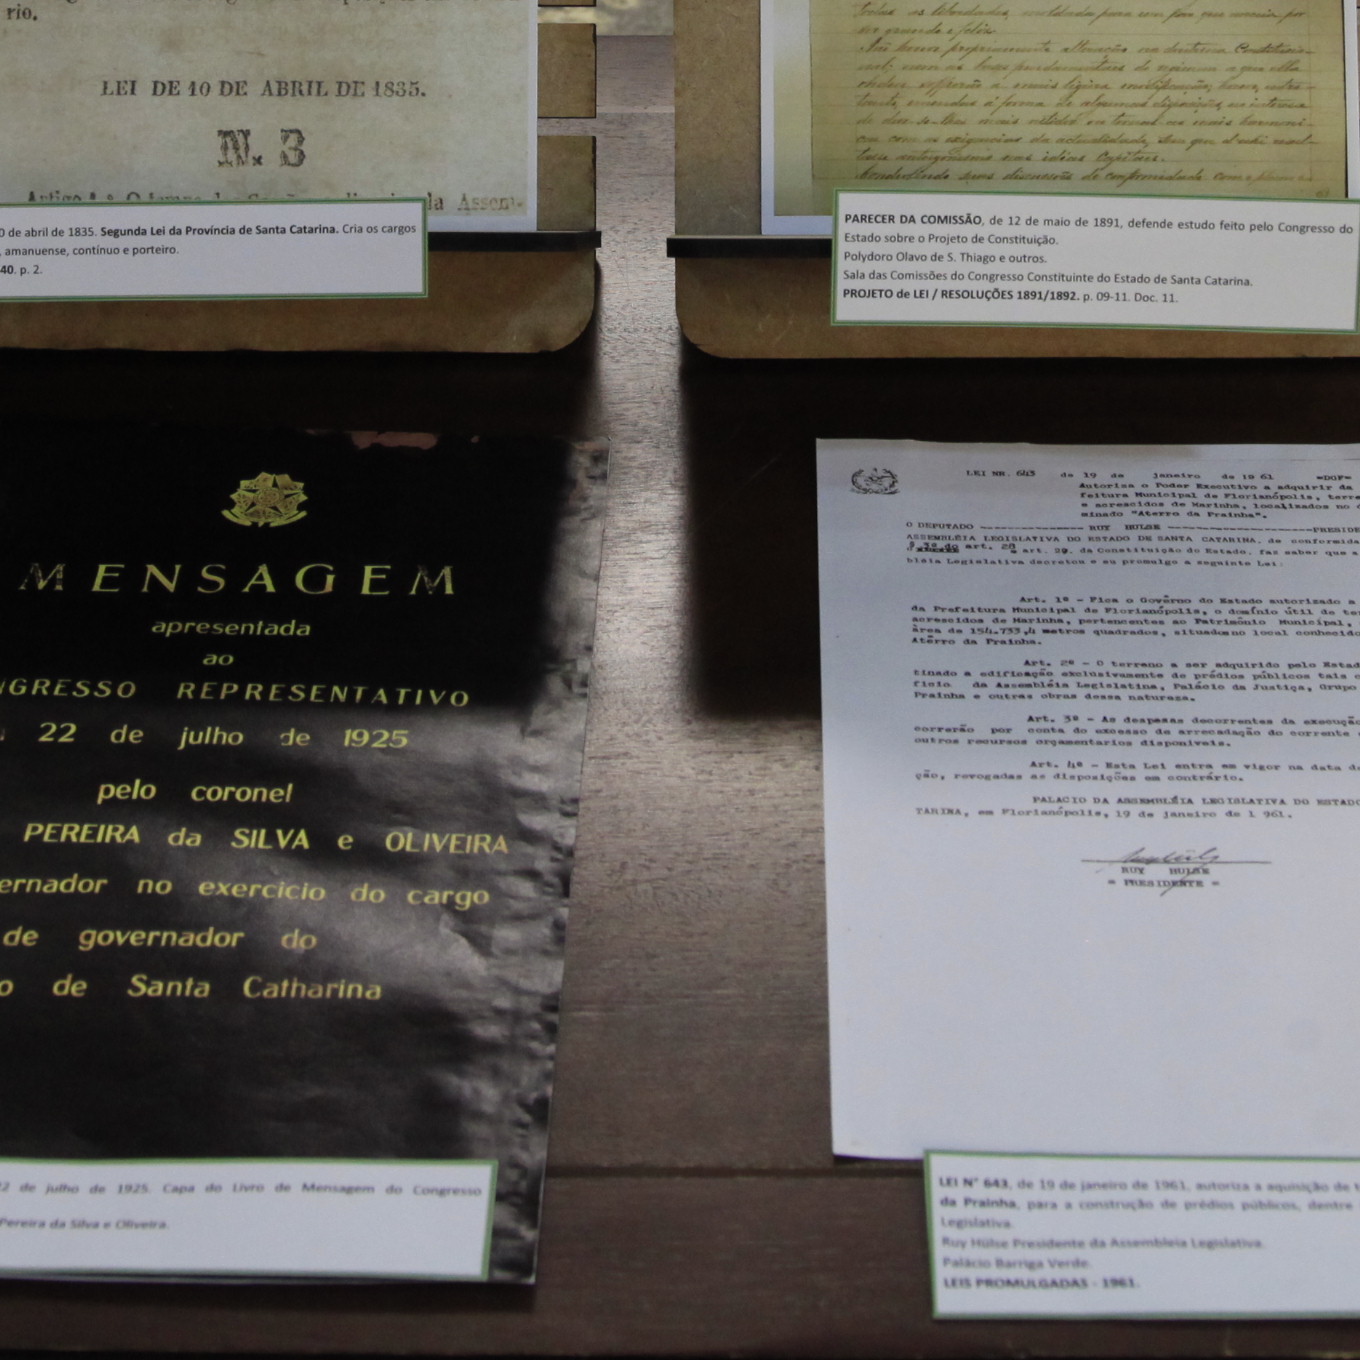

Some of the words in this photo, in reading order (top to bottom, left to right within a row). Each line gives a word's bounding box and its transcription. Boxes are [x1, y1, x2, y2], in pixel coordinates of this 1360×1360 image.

[100, 80, 137, 96] LEI
[152, 80, 180, 96] DE
[188, 80, 211, 97] 10
[219, 80, 248, 97] DE
[261, 79, 328, 97] ABRIL
[335, 80, 365, 97] DE
[374, 80, 426, 98] 1835.
[217, 129, 263, 167] N.
[280, 128, 306, 168] 3
[8, 227, 22, 238] de
[24, 227, 48, 238] abril
[51, 227, 65, 237] de
[68, 227, 97, 237] 1835.
[100, 226, 147, 239] Segunda
[150, 226, 166, 236] Lei
[169, 226, 182, 236] da
[185, 225, 236, 235] Província
[238, 225, 253, 235] de
[255, 225, 286, 235] Santa
[289, 224, 339, 234] Catarina.
[342, 224, 363, 234] Cria
[366, 225, 379, 234] os
[381, 225, 416, 236] cargos
[845, 214, 895, 224] PARECER
[900, 214, 916, 224] DA
[920, 213, 984, 226] COMISSÃO,
[989, 215, 1003, 226] de
[1008, 216, 1021, 226] 12
[1025, 216, 1039, 226] de
[1043, 217, 1071, 227] maio
[1074, 217, 1089, 227] de
[1094, 217, 1123, 229] 1891,
[1128, 218, 1173, 229] defende
[1177, 219, 1215, 230] estudo
[1219, 220, 1245, 231] feito
[1249, 221, 1274, 233] pelo
[1278, 222, 1335, 235] Congresso
[1339, 224, 1354, 234] do
[843, 288, 894, 299] PROJETO
[896, 289, 910, 299] de
[913, 289, 929, 299] LEI
[941, 287, 1014, 302] RESOLUÇÕES
[1017, 290, 1080, 302] 1891/1892.
[1096, 291, 1131, 302] 09-11.
[1134, 292, 1158, 303] Doc.
[1162, 293, 1178, 303] 11.
[19, 563, 454, 595] MENSAGEM
[151, 619, 311, 637] apresentada
[202, 654, 234, 665] ao
[177, 681, 471, 708] REPRESENTATIVO
[38, 722, 77, 743] 22
[110, 724, 144, 744] de
[177, 726, 244, 750] julho
[279, 727, 311, 747] de
[343, 728, 409, 748] 1925
[97, 778, 156, 805] pelo
[191, 783, 293, 803] coronel
[23, 823, 140, 844] PEREIRA
[167, 827, 202, 847] da
[230, 828, 309, 850] SILVA
[337, 834, 354, 850] e
[385, 827, 509, 855] OLIVEIRA
[137, 879, 173, 895] no
[197, 878, 327, 901] exercicio
[350, 883, 386, 905] do
[406, 887, 490, 909] cargo
[3, 926, 39, 947] de
[78, 926, 245, 951] governador
[281, 929, 317, 951] do
[52, 973, 87, 997] de
[127, 974, 210, 998] Santa
[243, 971, 386, 1000] Catharina
[19, 1182, 36, 1193] de
[45, 1183, 80, 1195] julho
[89, 1183, 106, 1194] de
